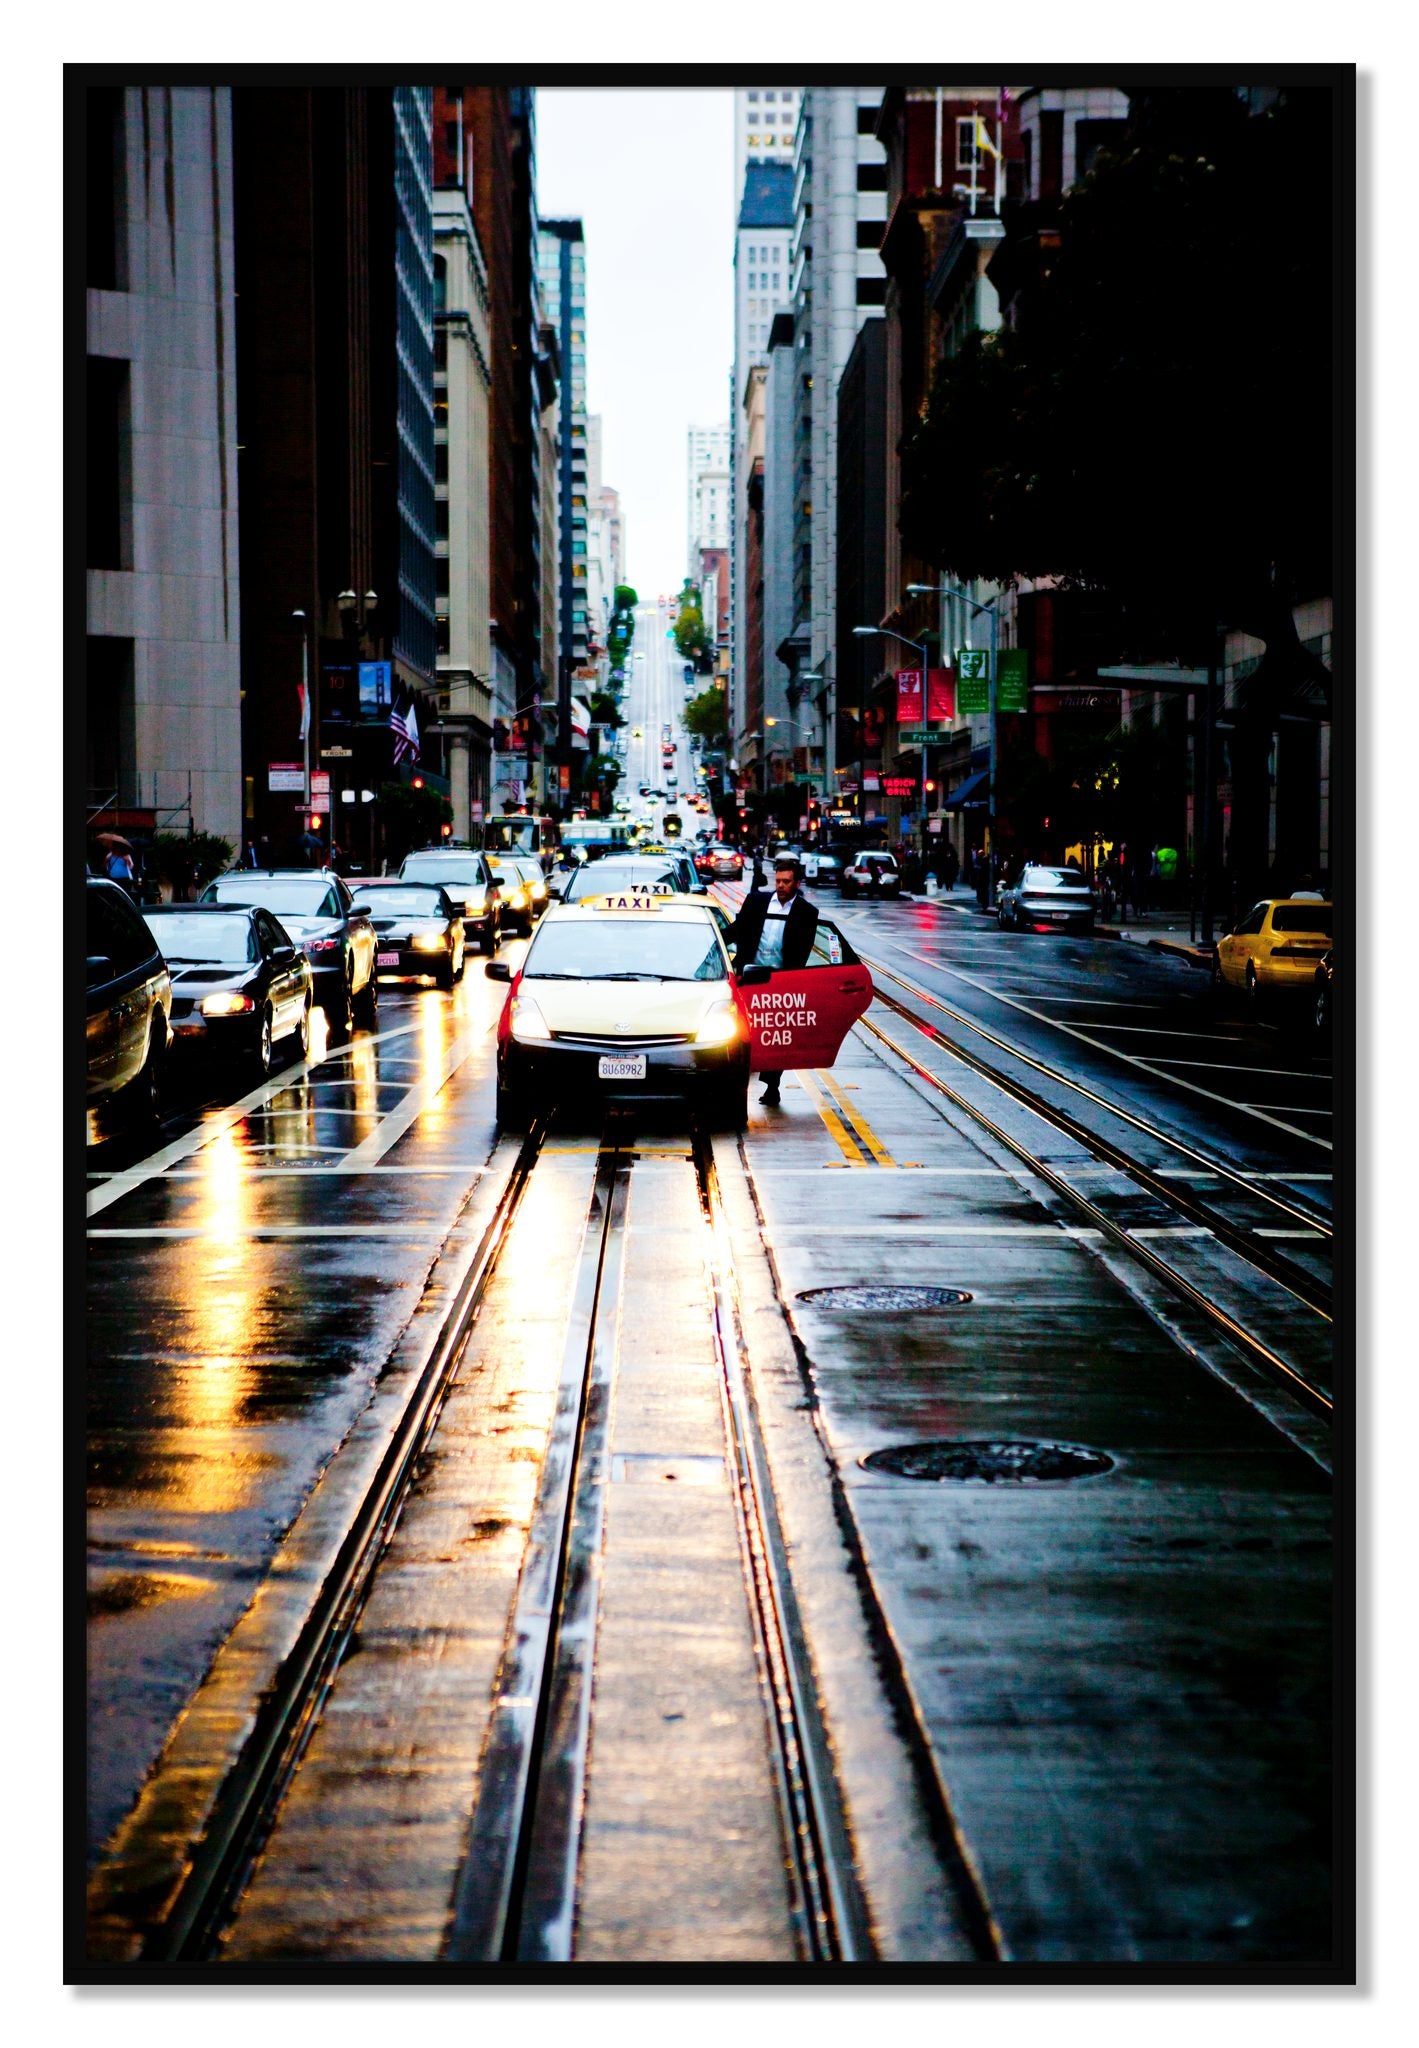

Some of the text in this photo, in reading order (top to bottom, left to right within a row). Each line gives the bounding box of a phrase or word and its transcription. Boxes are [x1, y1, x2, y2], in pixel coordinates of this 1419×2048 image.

[913, 733, 939, 742] Front
[882, 778, 916, 788] TADICH
[886, 787, 912, 796] GRILL
[631, 885, 667, 894] TAXI
[605, 897, 651, 909] TAXI
[750, 992, 807, 1009] ARROW
[760, 1029, 792, 1047] CAB
[602, 1063, 643, 1076] 8U68982
